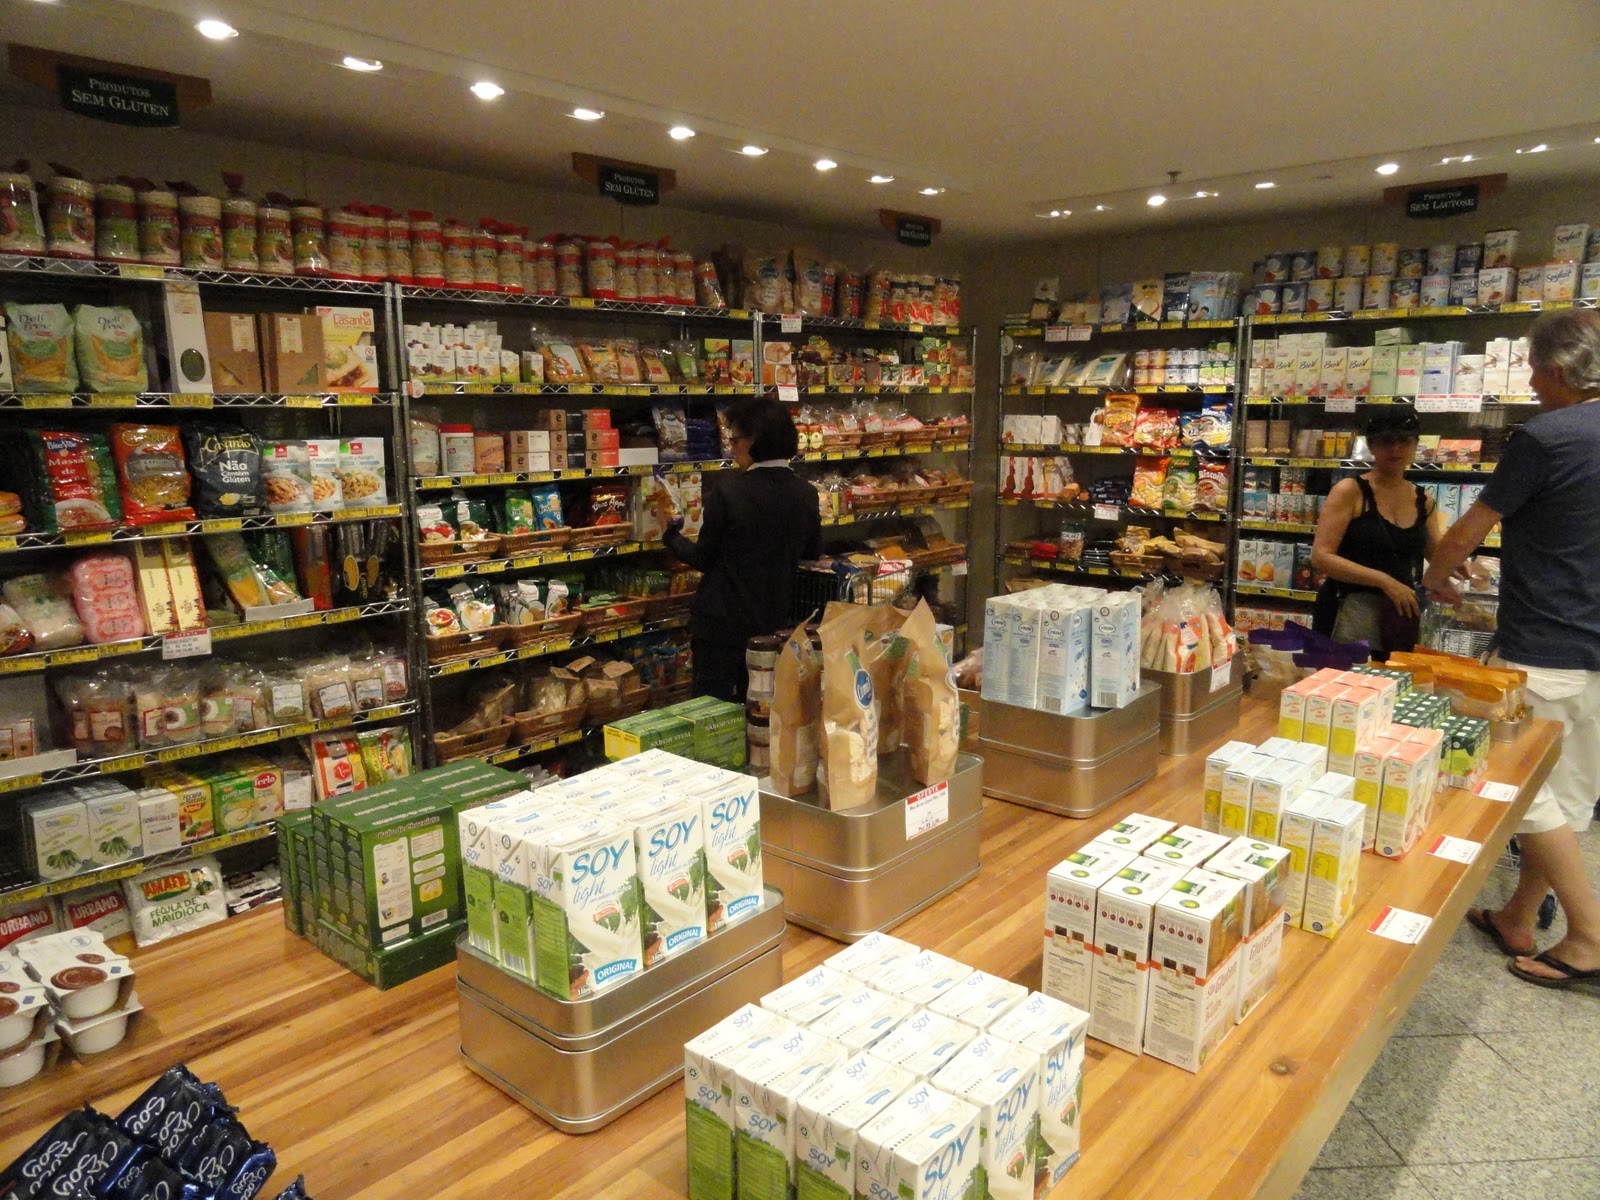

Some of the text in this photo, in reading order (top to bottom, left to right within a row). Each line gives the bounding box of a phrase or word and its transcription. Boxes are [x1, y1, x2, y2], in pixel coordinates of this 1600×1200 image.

[89, 78, 151, 98] PRODUTOS
[72, 89, 169, 117] SEM GLUTEN
[605, 181, 622, 193] SEM
[1410, 198, 1475, 212] SEM LACTOSE
[333, 313, 372, 326] Lasanha
[219, 460, 248, 472] Não
[650, 735, 673, 747] SABOR
[711, 790, 755, 831] SOY
[648, 815, 698, 858] SOY
[712, 824, 737, 856] light
[465, 848, 480, 861] SOY
[571, 839, 631, 885] SOY
[498, 862, 515, 876] SOY
[650, 851, 678, 883] light
[536, 877, 554, 891] SOY
[572, 873, 607, 911] light
[72, 895, 119, 920] URBANO
[184, 897, 198, 907] DE
[728, 897, 758, 914] ORIGINAL
[0, 910, 49, 936] URBANO
[152, 902, 210, 928] MANDIOCA
[668, 928, 699, 947] ORIGINAL
[863, 935, 881, 950] SOY
[597, 961, 635, 981] ORIGINAL
[915, 955, 933, 969] SOY
[806, 970, 825, 988] SOY
[967, 972, 986, 991] SOY
[852, 992, 872, 1007] SOY
[1026, 996, 1045, 1014] SOY
[733, 1009, 754, 1029] SOY
[911, 1013, 931, 1032] SOY
[783, 1032, 804, 1053] SOY
[972, 1038, 993, 1057] SOY
[1046, 1028, 1084, 1085] SOY
[846, 1058, 868, 1078] SOY
[697, 1086, 722, 1104] SOY
[907, 1086, 930, 1110] SOY
[994, 1072, 1036, 1138] SOY
[748, 1114, 778, 1133] SOY
[22, 1141, 69, 1178] Soy
[808, 1146, 836, 1168] SOY
[922, 1125, 975, 1199] SOY
[53, 1154, 101, 1196] Soy
[869, 1182, 899, 1200] SOY
